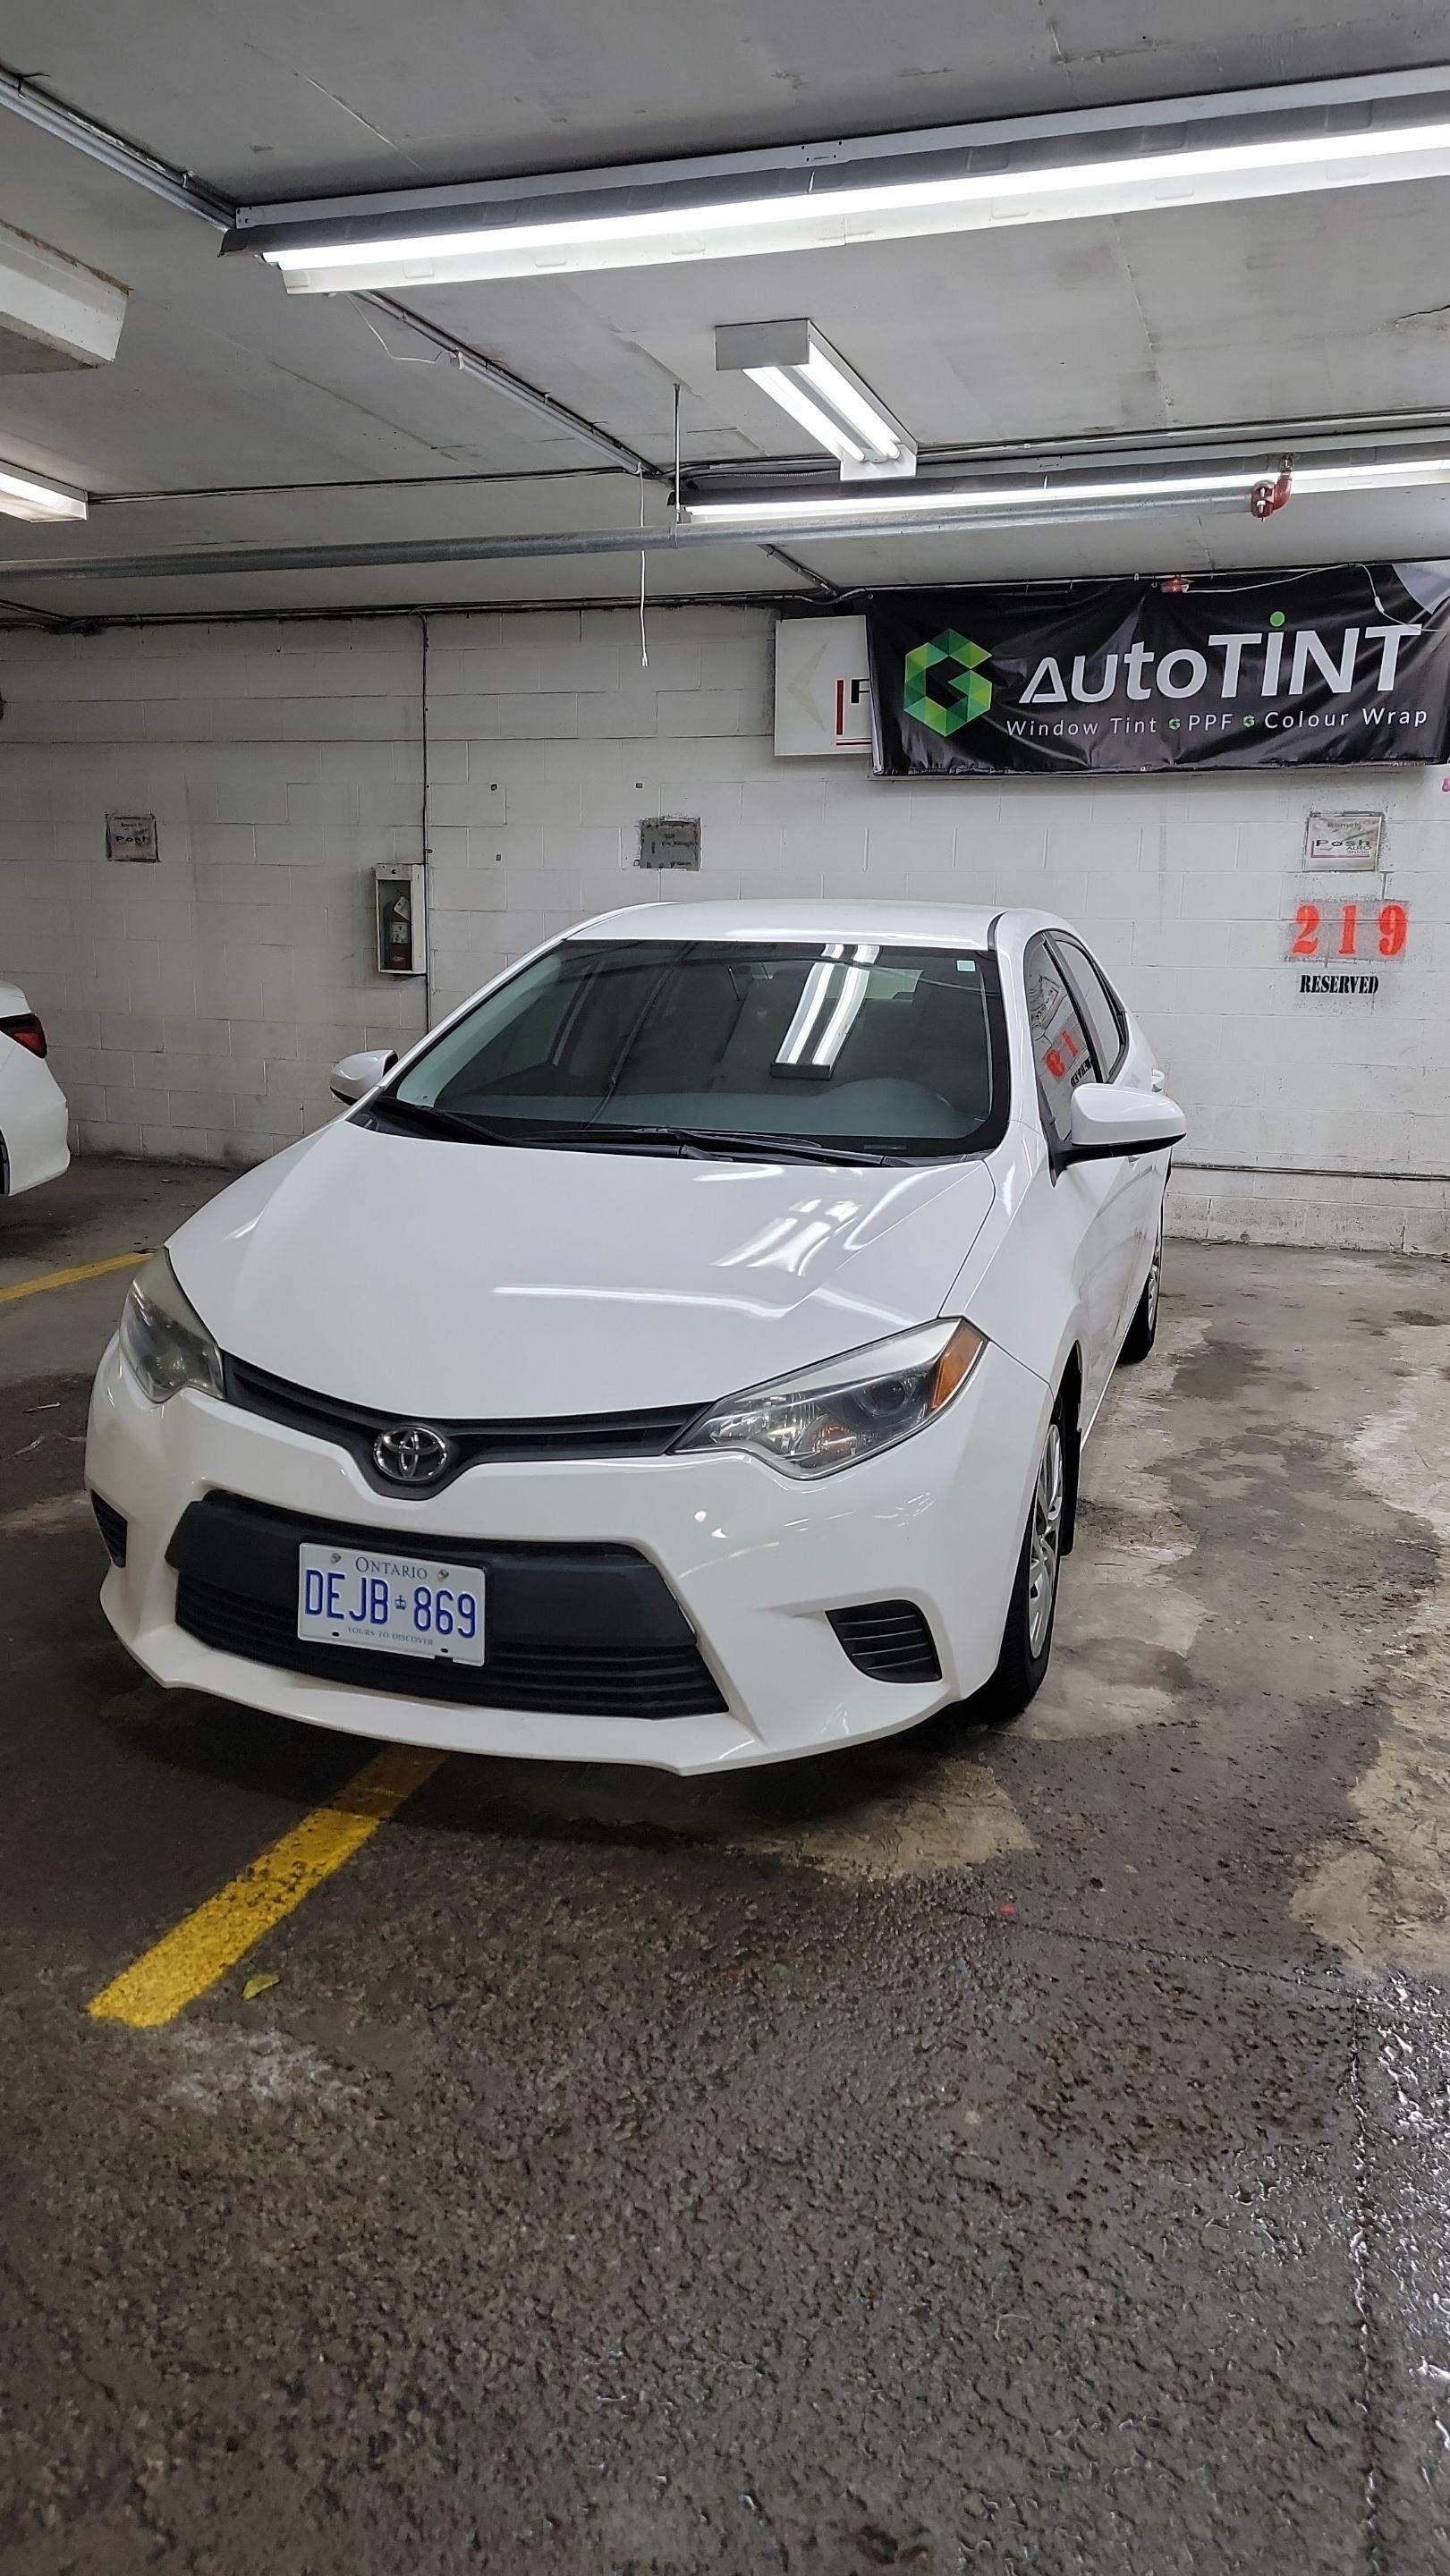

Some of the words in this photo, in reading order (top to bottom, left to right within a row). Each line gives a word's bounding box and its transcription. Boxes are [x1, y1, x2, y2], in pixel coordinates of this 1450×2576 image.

[1005, 718, 1099, 737] Window
[1110, 716, 1157, 734] Tint
[1188, 713, 1234, 732] PPF
[1264, 709, 1349, 729] Colour
[1361, 707, 1428, 728] Wrap
[1315, 839, 1370, 847] Posh
[1299, 973, 1379, 995] RESERVED
[355, 1556, 428, 1580] ONTARIO
[304, 1569, 389, 1625] DEJB
[413, 1586, 476, 1640] 869
[347, 1626, 375, 1637] YOURS
[377, 1630, 389, 1639] TO
[392, 1633, 434, 1646] DISCOVER
